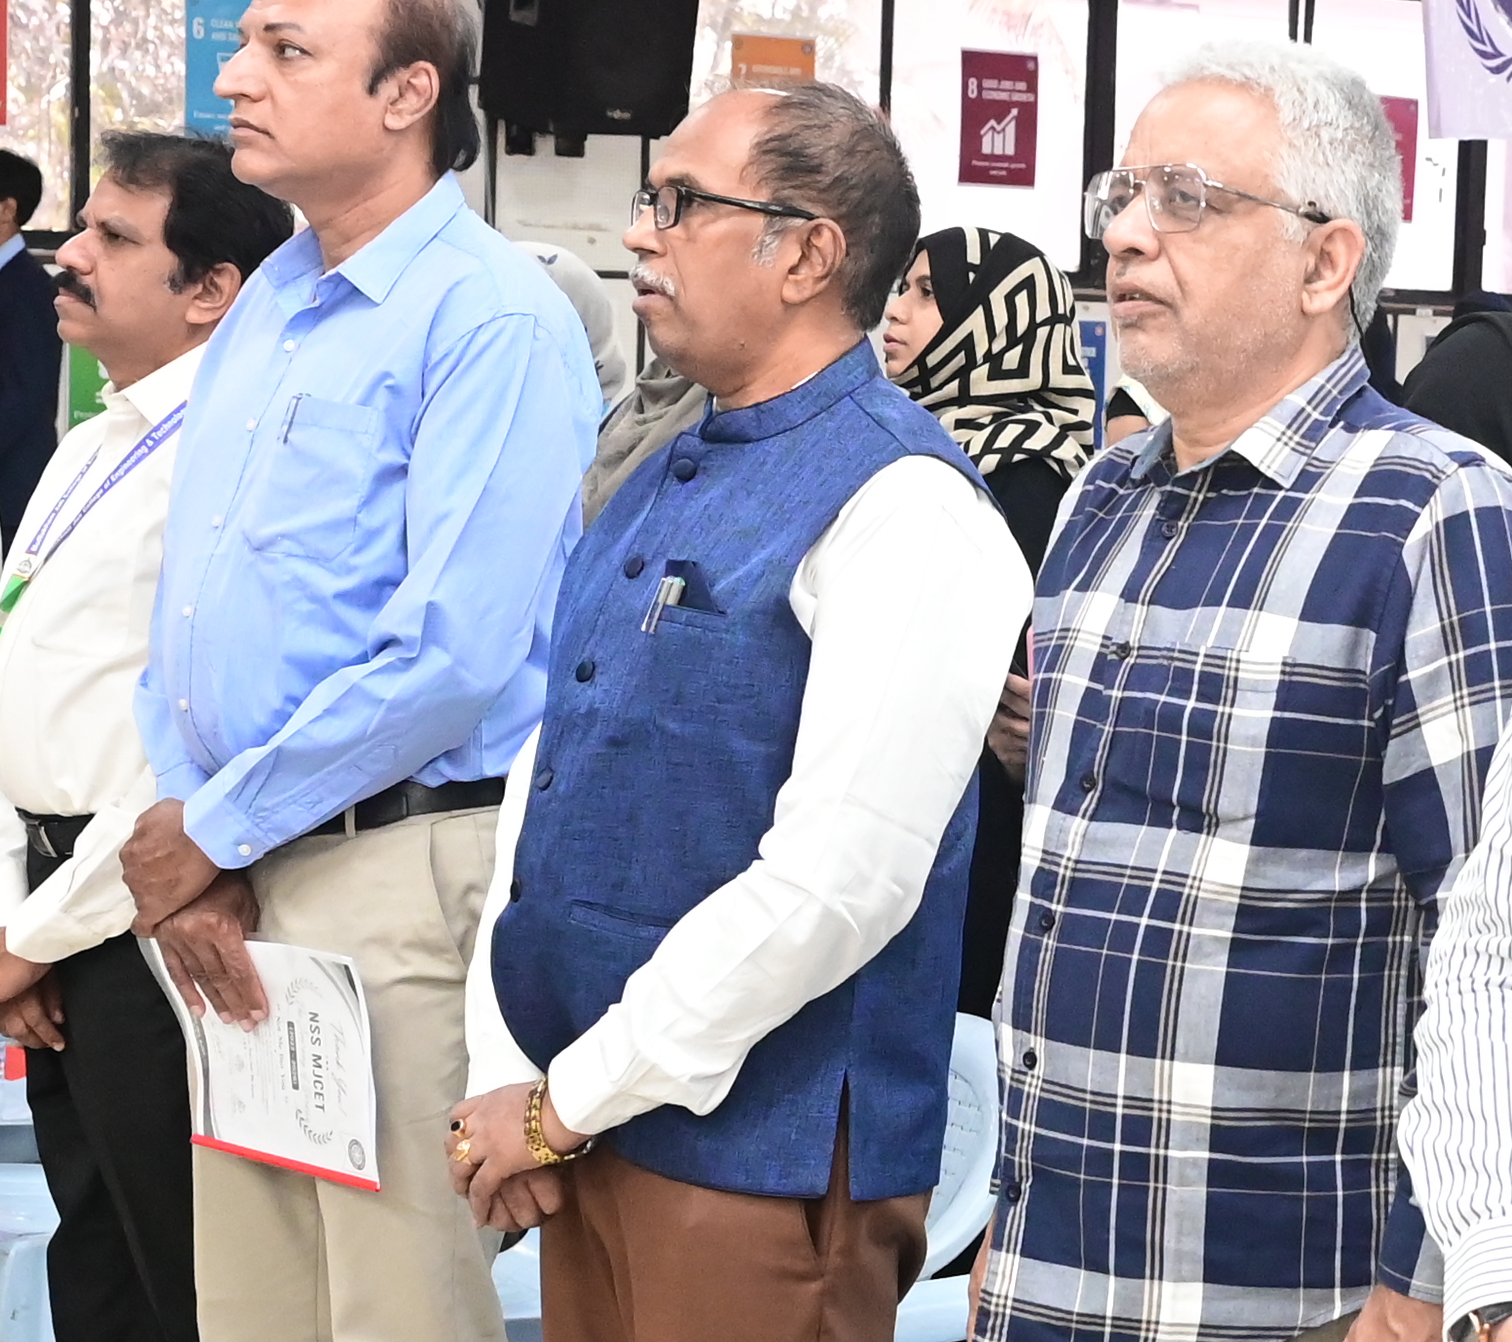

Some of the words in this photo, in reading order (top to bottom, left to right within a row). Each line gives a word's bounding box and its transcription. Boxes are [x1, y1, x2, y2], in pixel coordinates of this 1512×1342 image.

[192, 16, 205, 40] 6
[967, 77, 978, 99] 8
[308, 1011, 322, 1047] NSS
[311, 1053, 326, 1113] MJCET
